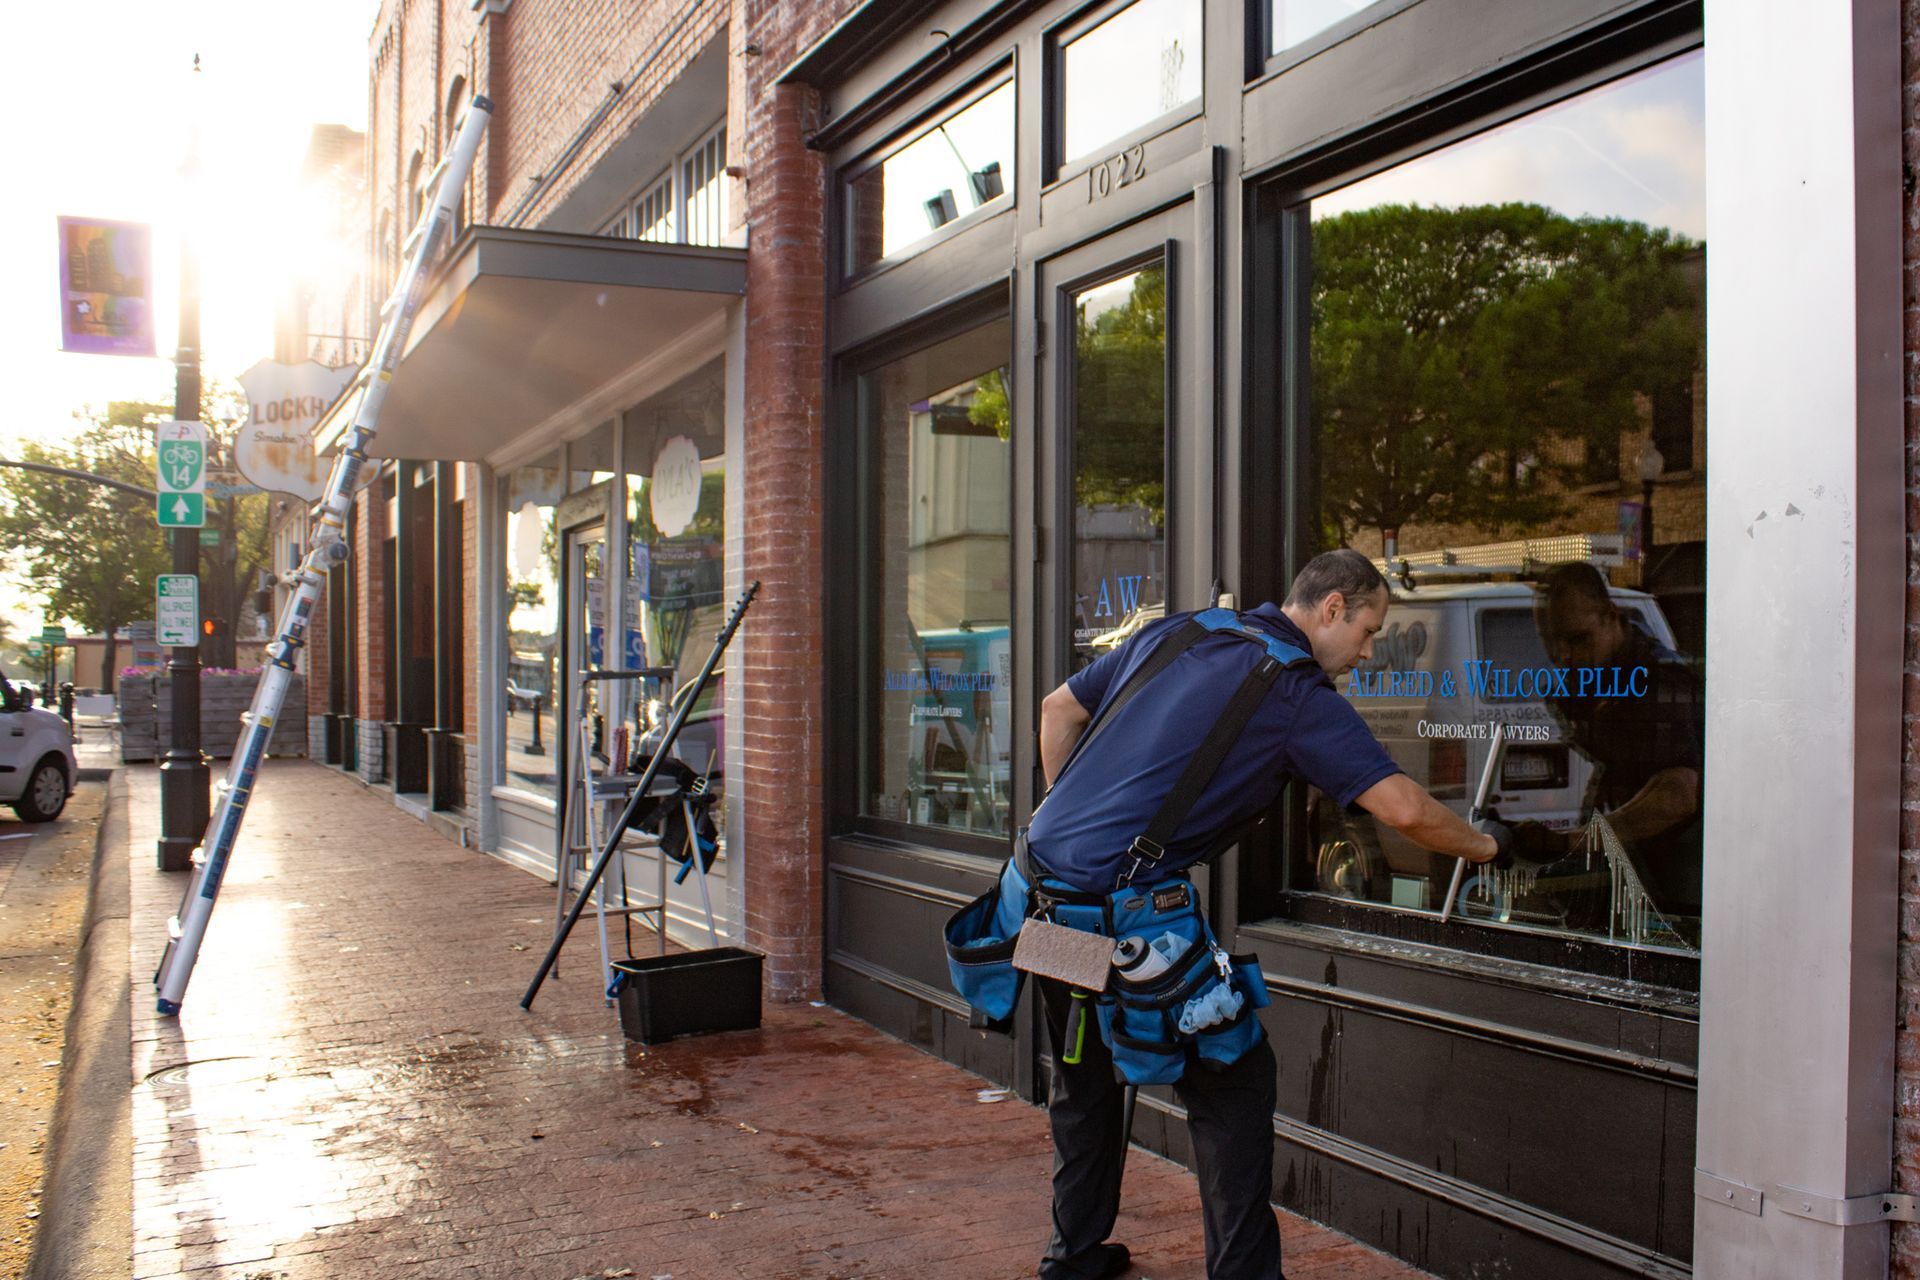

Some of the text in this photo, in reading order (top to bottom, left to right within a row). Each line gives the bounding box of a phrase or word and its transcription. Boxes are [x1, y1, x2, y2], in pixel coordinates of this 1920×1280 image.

[1087, 143, 1146, 204] 1022
[171, 465, 190, 486] 14
[160, 581, 168, 594] 3
[929, 667, 969, 691] WILCOX
[1345, 660, 1648, 698] ALLRED & WILCOX PLLC
[1417, 719, 1486, 739] CORPORATE
